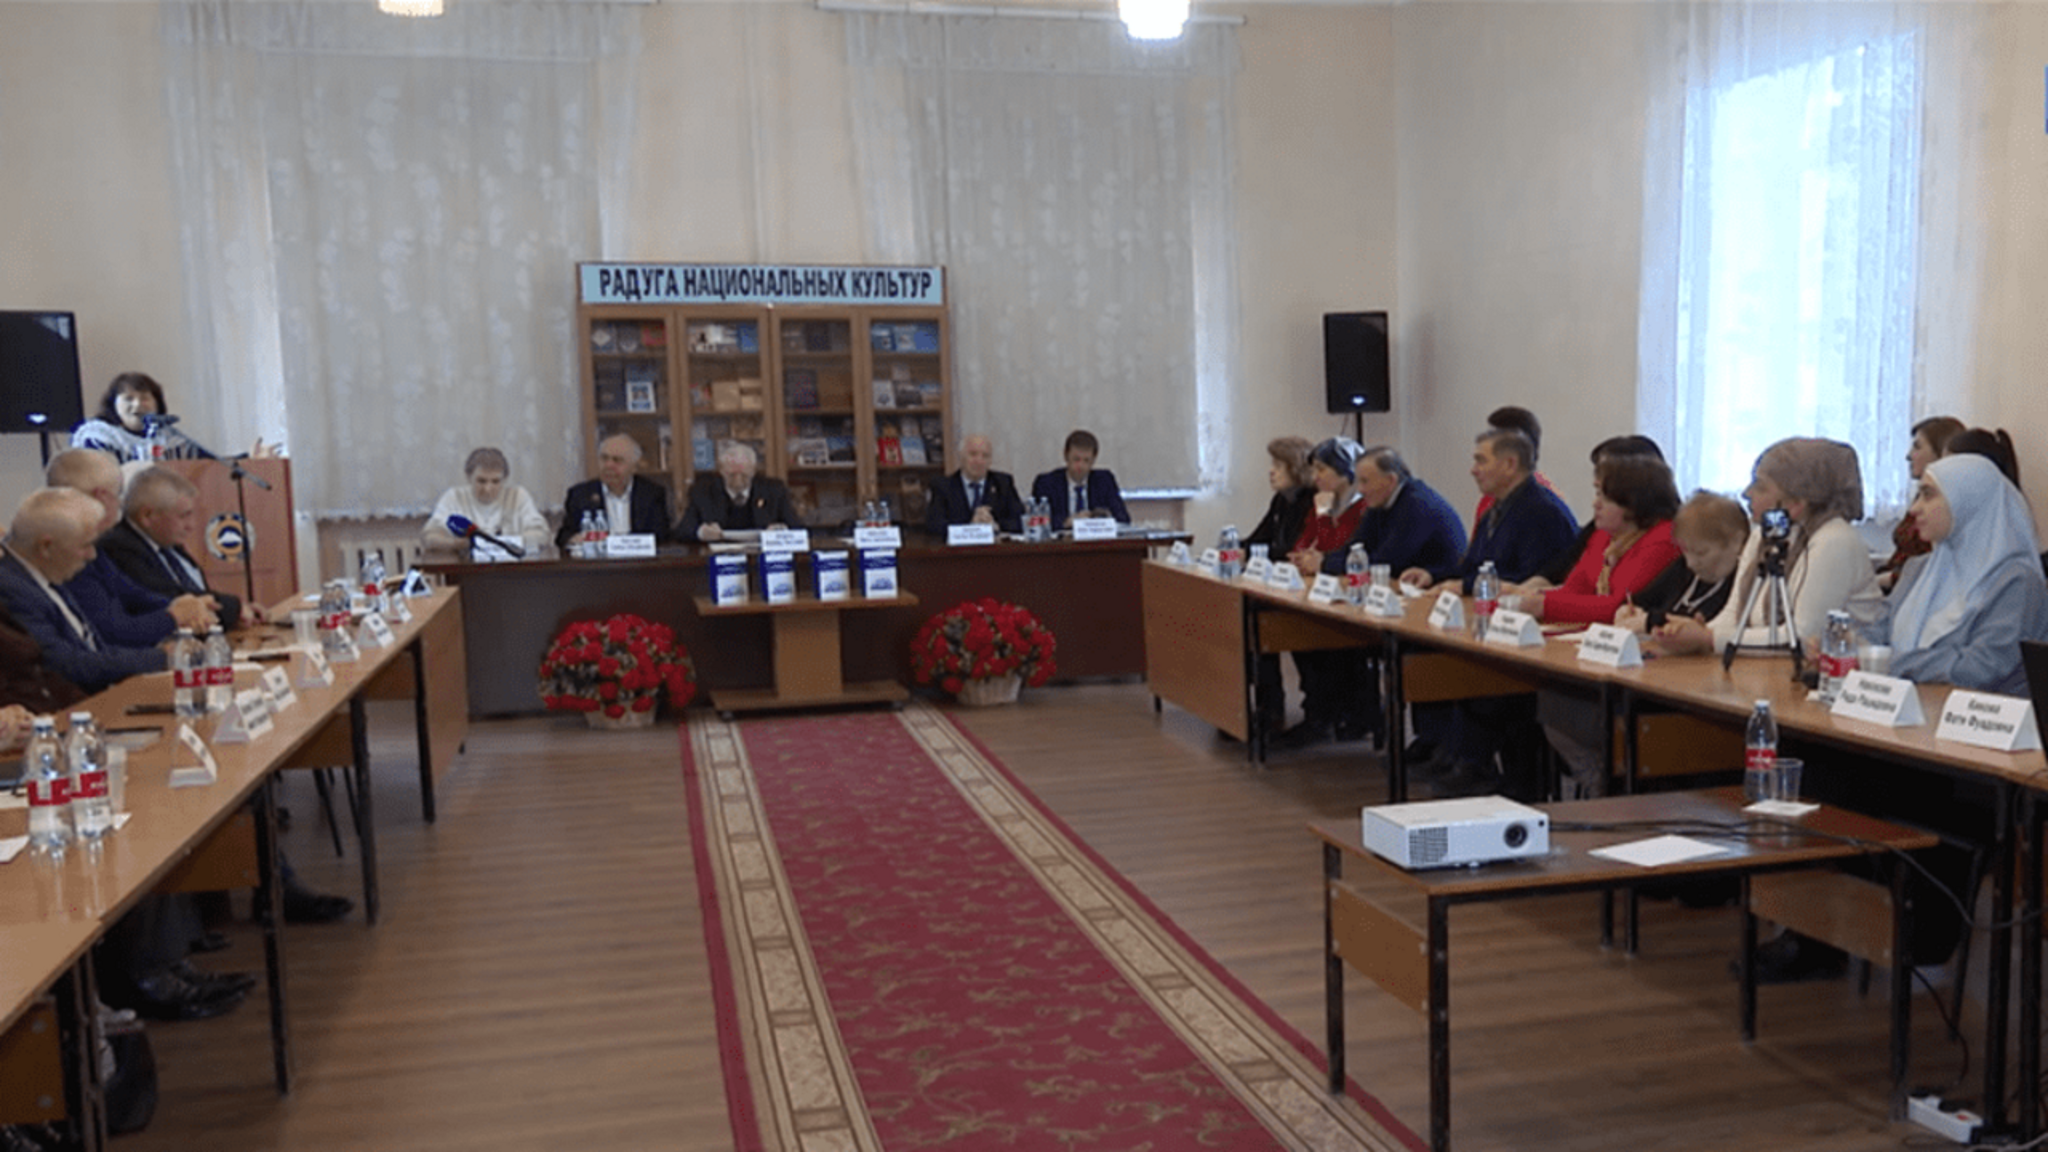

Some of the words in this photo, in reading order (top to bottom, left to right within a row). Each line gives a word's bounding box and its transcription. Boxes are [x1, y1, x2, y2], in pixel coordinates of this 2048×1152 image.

[599, 268, 679, 301] РАДУГА
[683, 268, 846, 300] НАЦИОНАЛЬНЫХ
[851, 270, 931, 299] КУЛЬТУР
